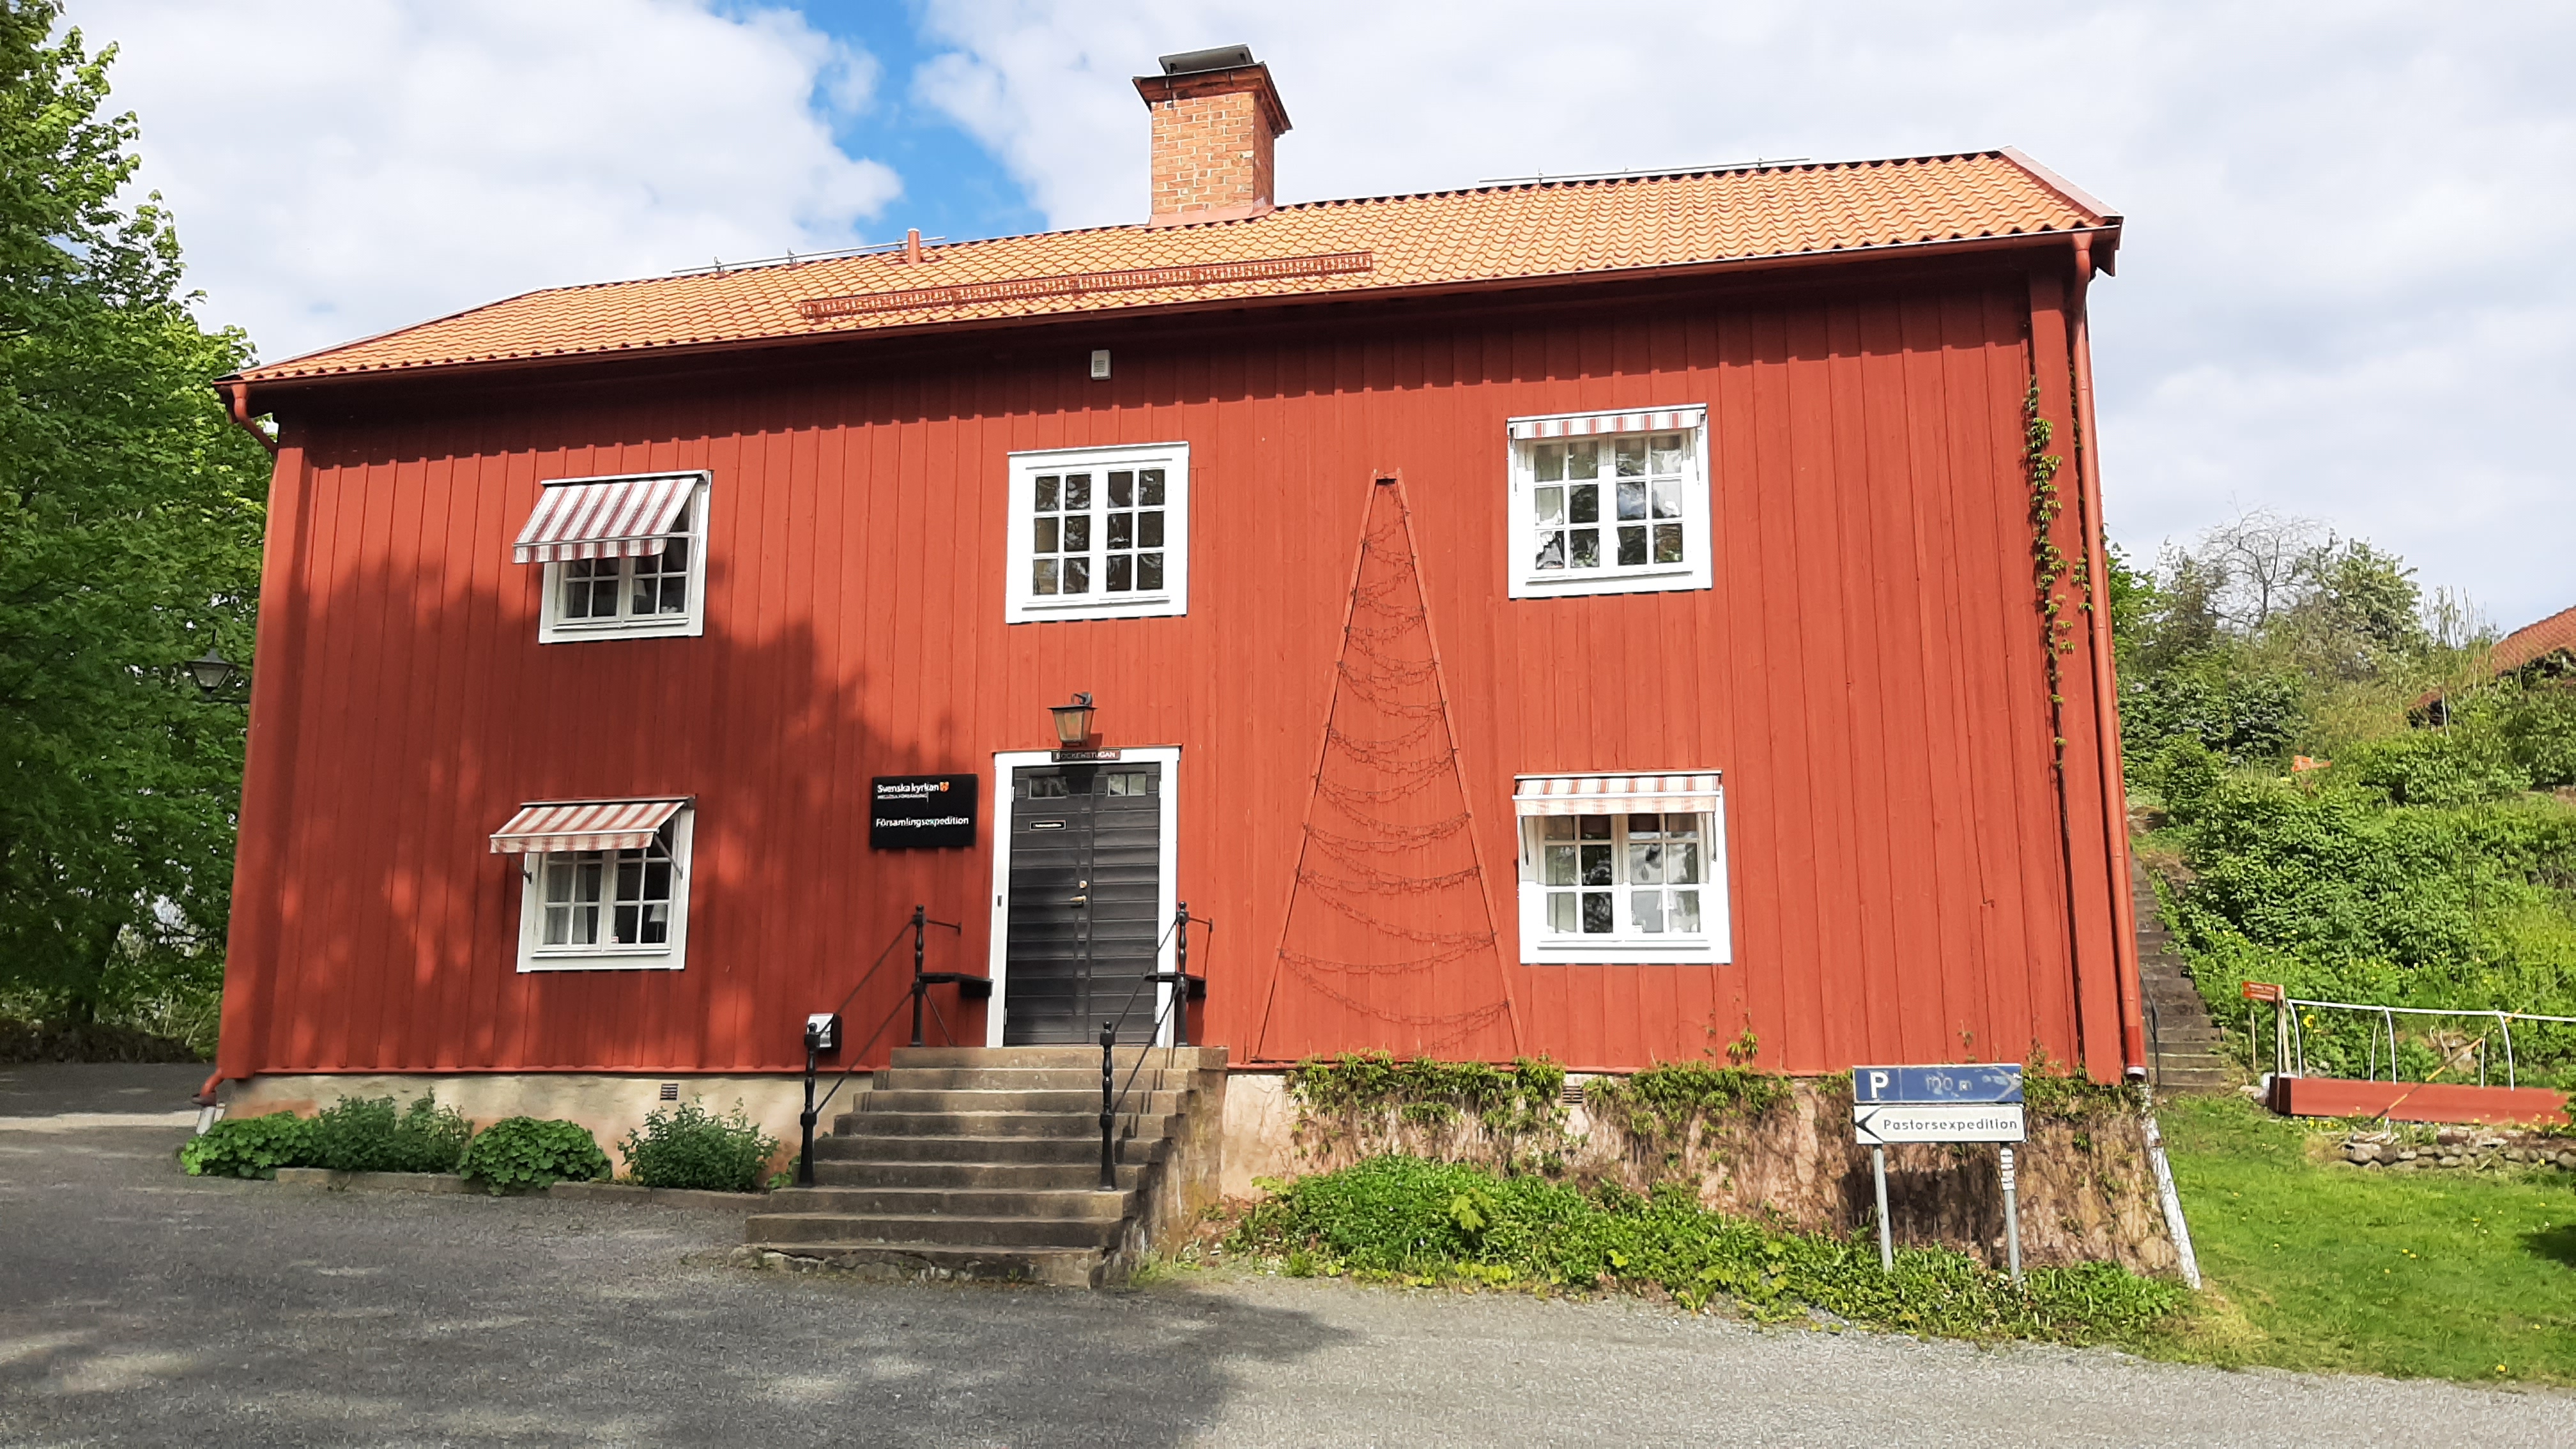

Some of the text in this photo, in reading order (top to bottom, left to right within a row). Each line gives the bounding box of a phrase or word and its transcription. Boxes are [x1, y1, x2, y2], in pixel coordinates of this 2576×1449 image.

[877, 782, 939, 793] Svenska kyrkan
[876, 816, 969, 828] Församlingsexpedition
[1869, 1071, 1889, 1099] P
[1958, 1079, 1973, 1091] m
[1883, 1117, 2018, 1131] Pastorsexpedition
